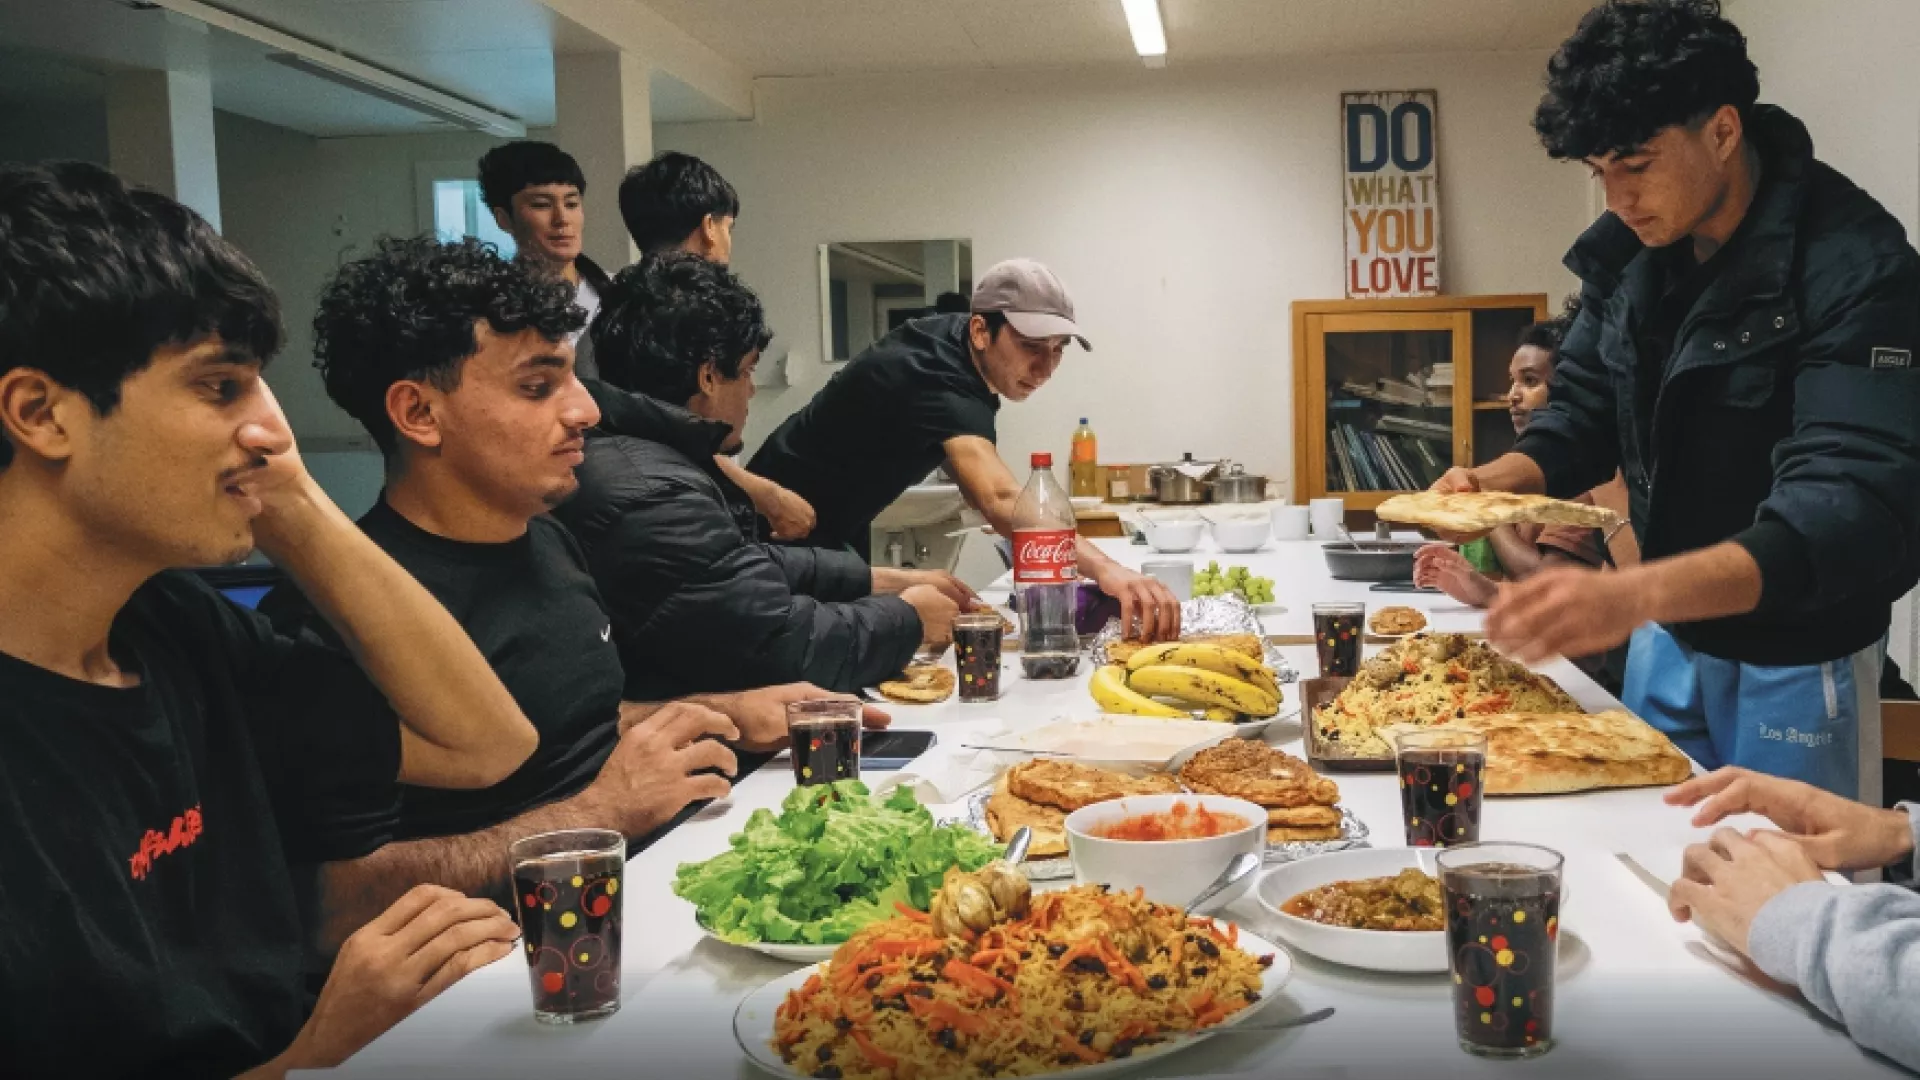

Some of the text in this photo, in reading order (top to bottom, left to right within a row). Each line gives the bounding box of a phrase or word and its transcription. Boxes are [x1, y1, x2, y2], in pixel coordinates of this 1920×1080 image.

[1347, 101, 1433, 173] DO
[1348, 175, 1434, 206] WHAT
[1349, 207, 1434, 254] YOU
[1350, 257, 1438, 294] LOVE
[1759, 721, 1783, 741] Los
